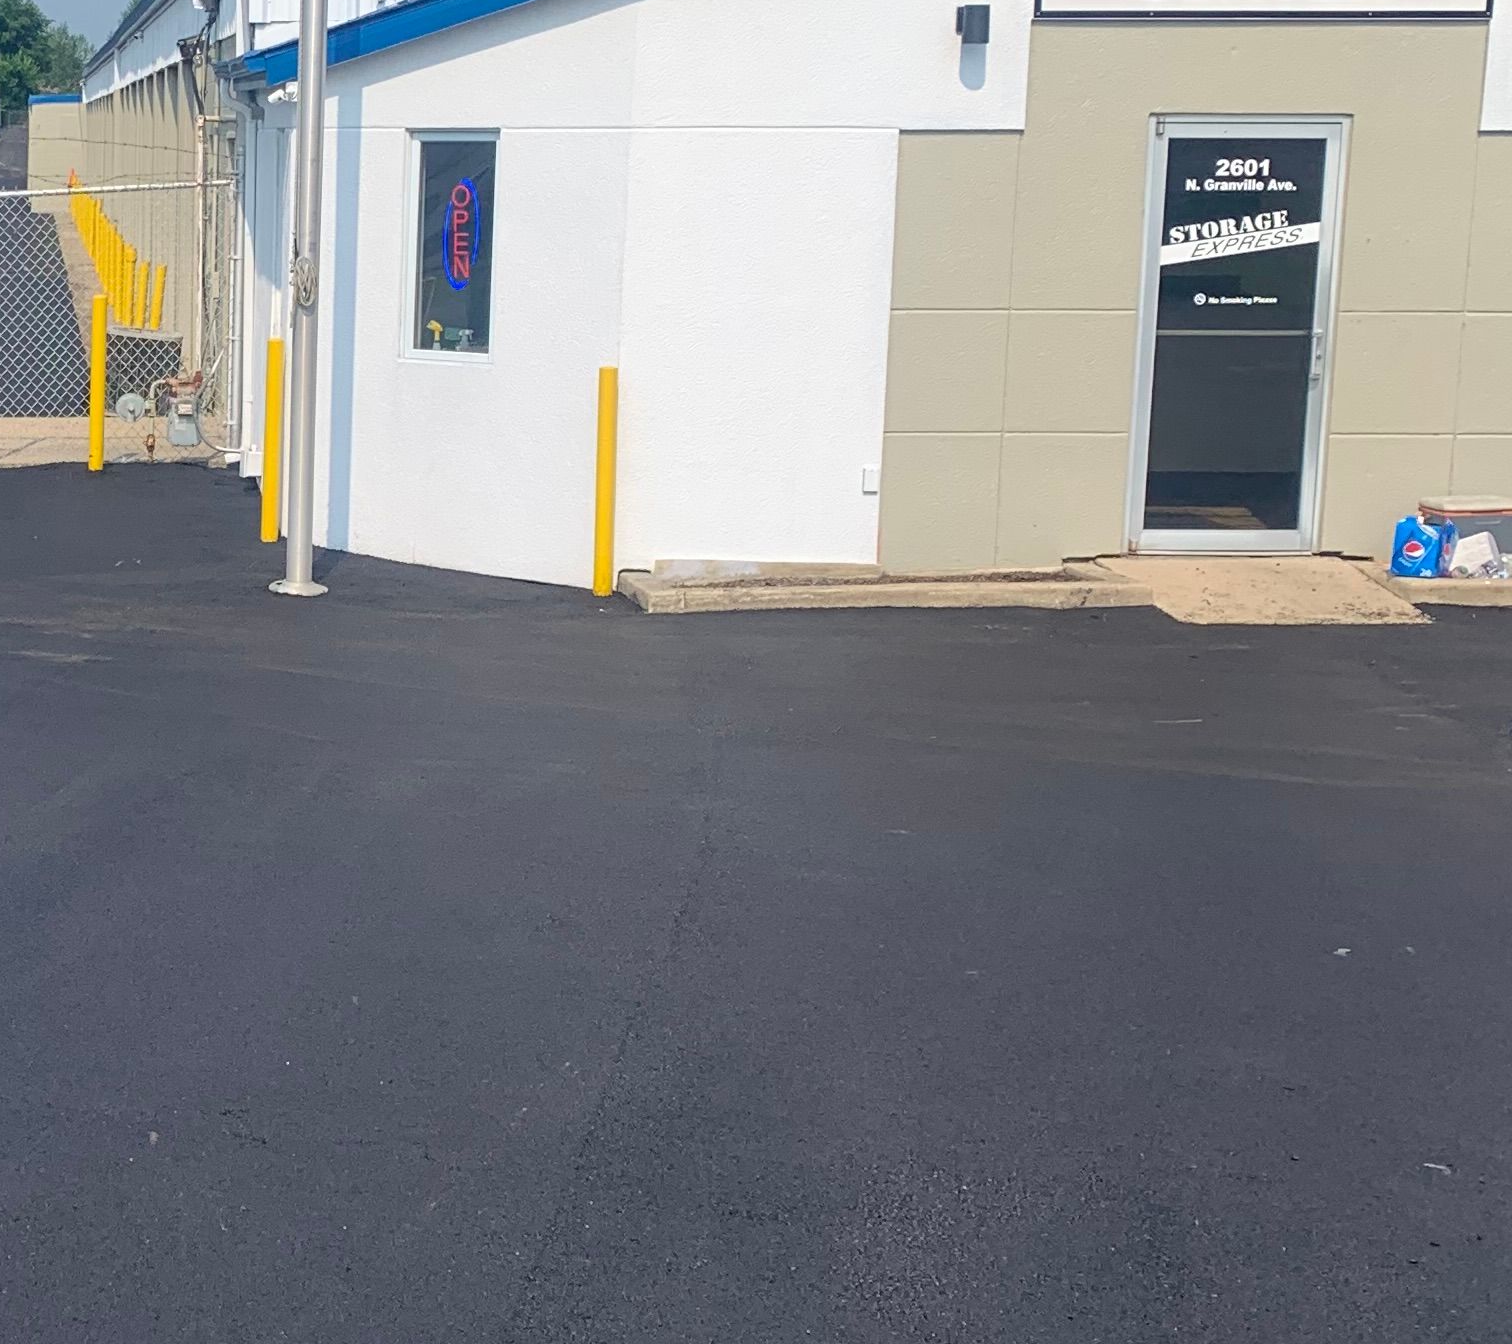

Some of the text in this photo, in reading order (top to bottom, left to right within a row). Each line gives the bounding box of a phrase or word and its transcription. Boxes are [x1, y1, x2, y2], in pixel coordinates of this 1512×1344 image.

[1215, 159, 1270, 176] 2601
[1185, 179, 1297, 191] N. Granville Ave.
[451, 184, 471, 278] OPEN
[1169, 210, 1289, 244] STORAGE
[1191, 227, 1303, 258] EXPRESS
